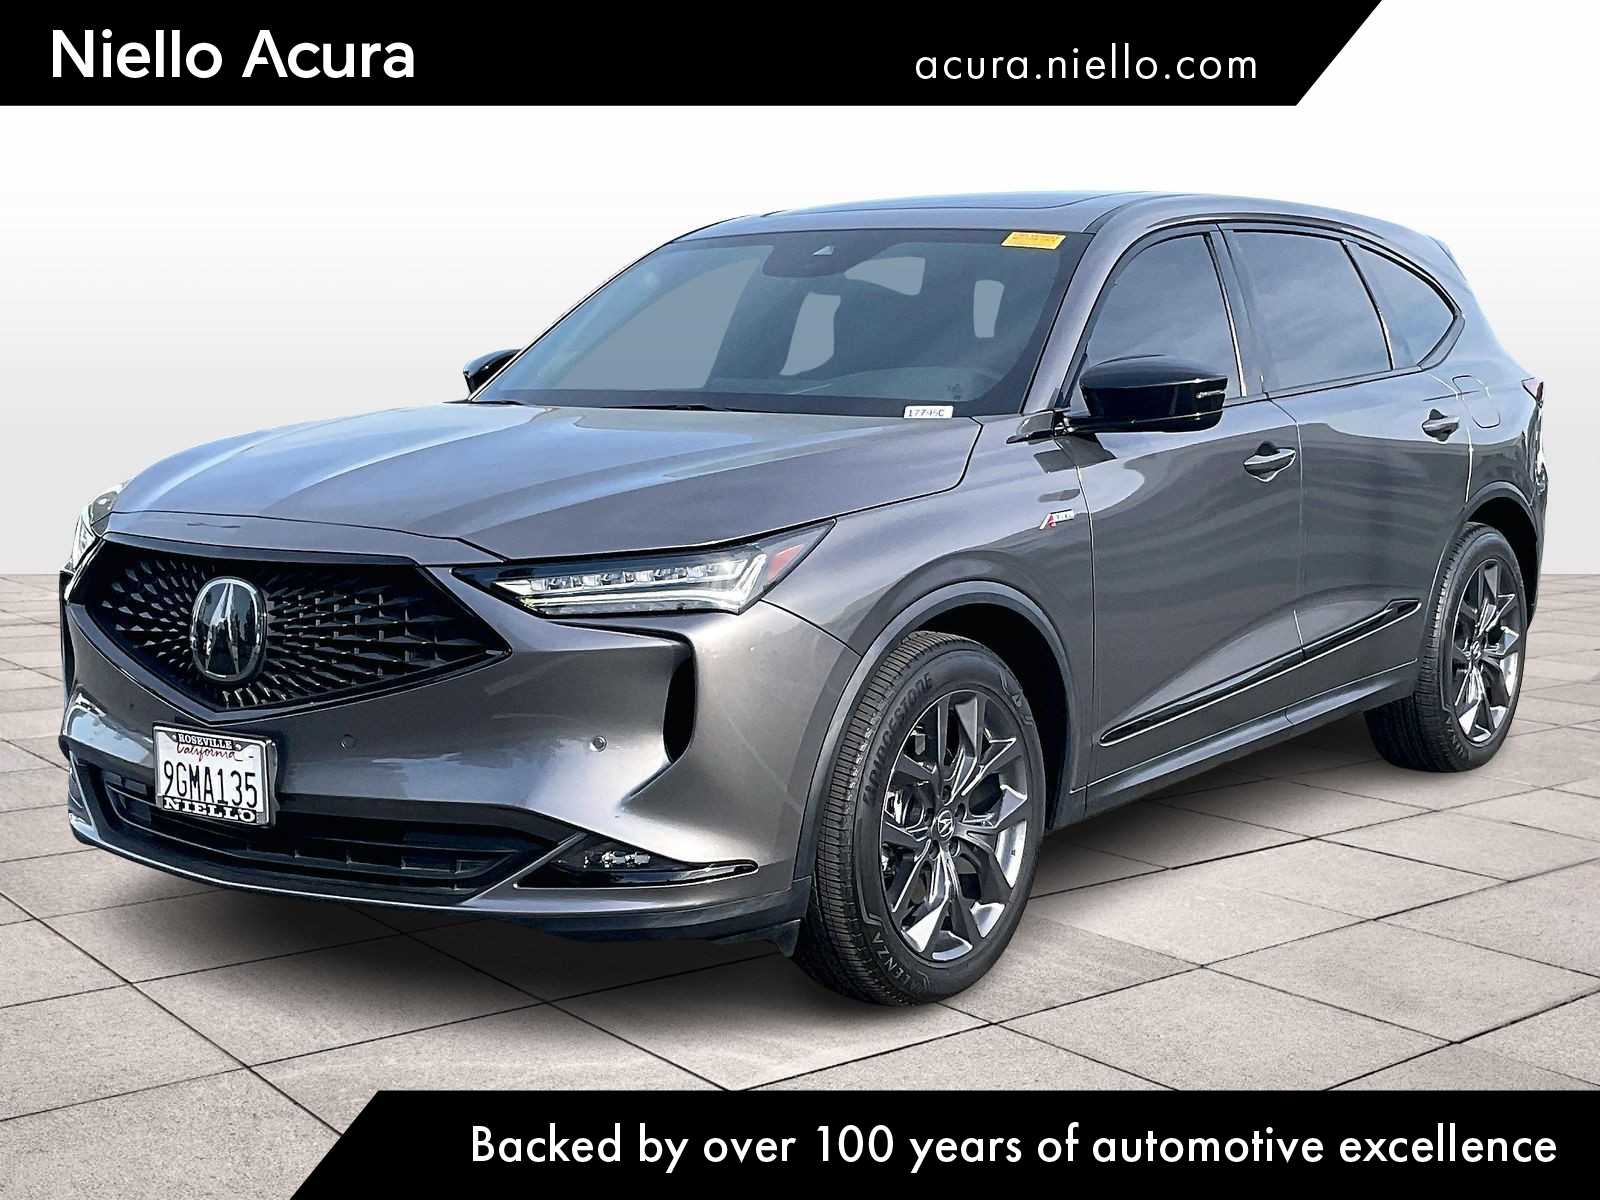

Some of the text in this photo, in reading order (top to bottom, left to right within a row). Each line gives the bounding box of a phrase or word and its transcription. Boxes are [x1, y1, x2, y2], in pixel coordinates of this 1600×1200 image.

[178, 732, 234, 750] ROSEVILLE
[163, 760, 257, 808] 9GMA135
[163, 796, 256, 823] NIELLO
